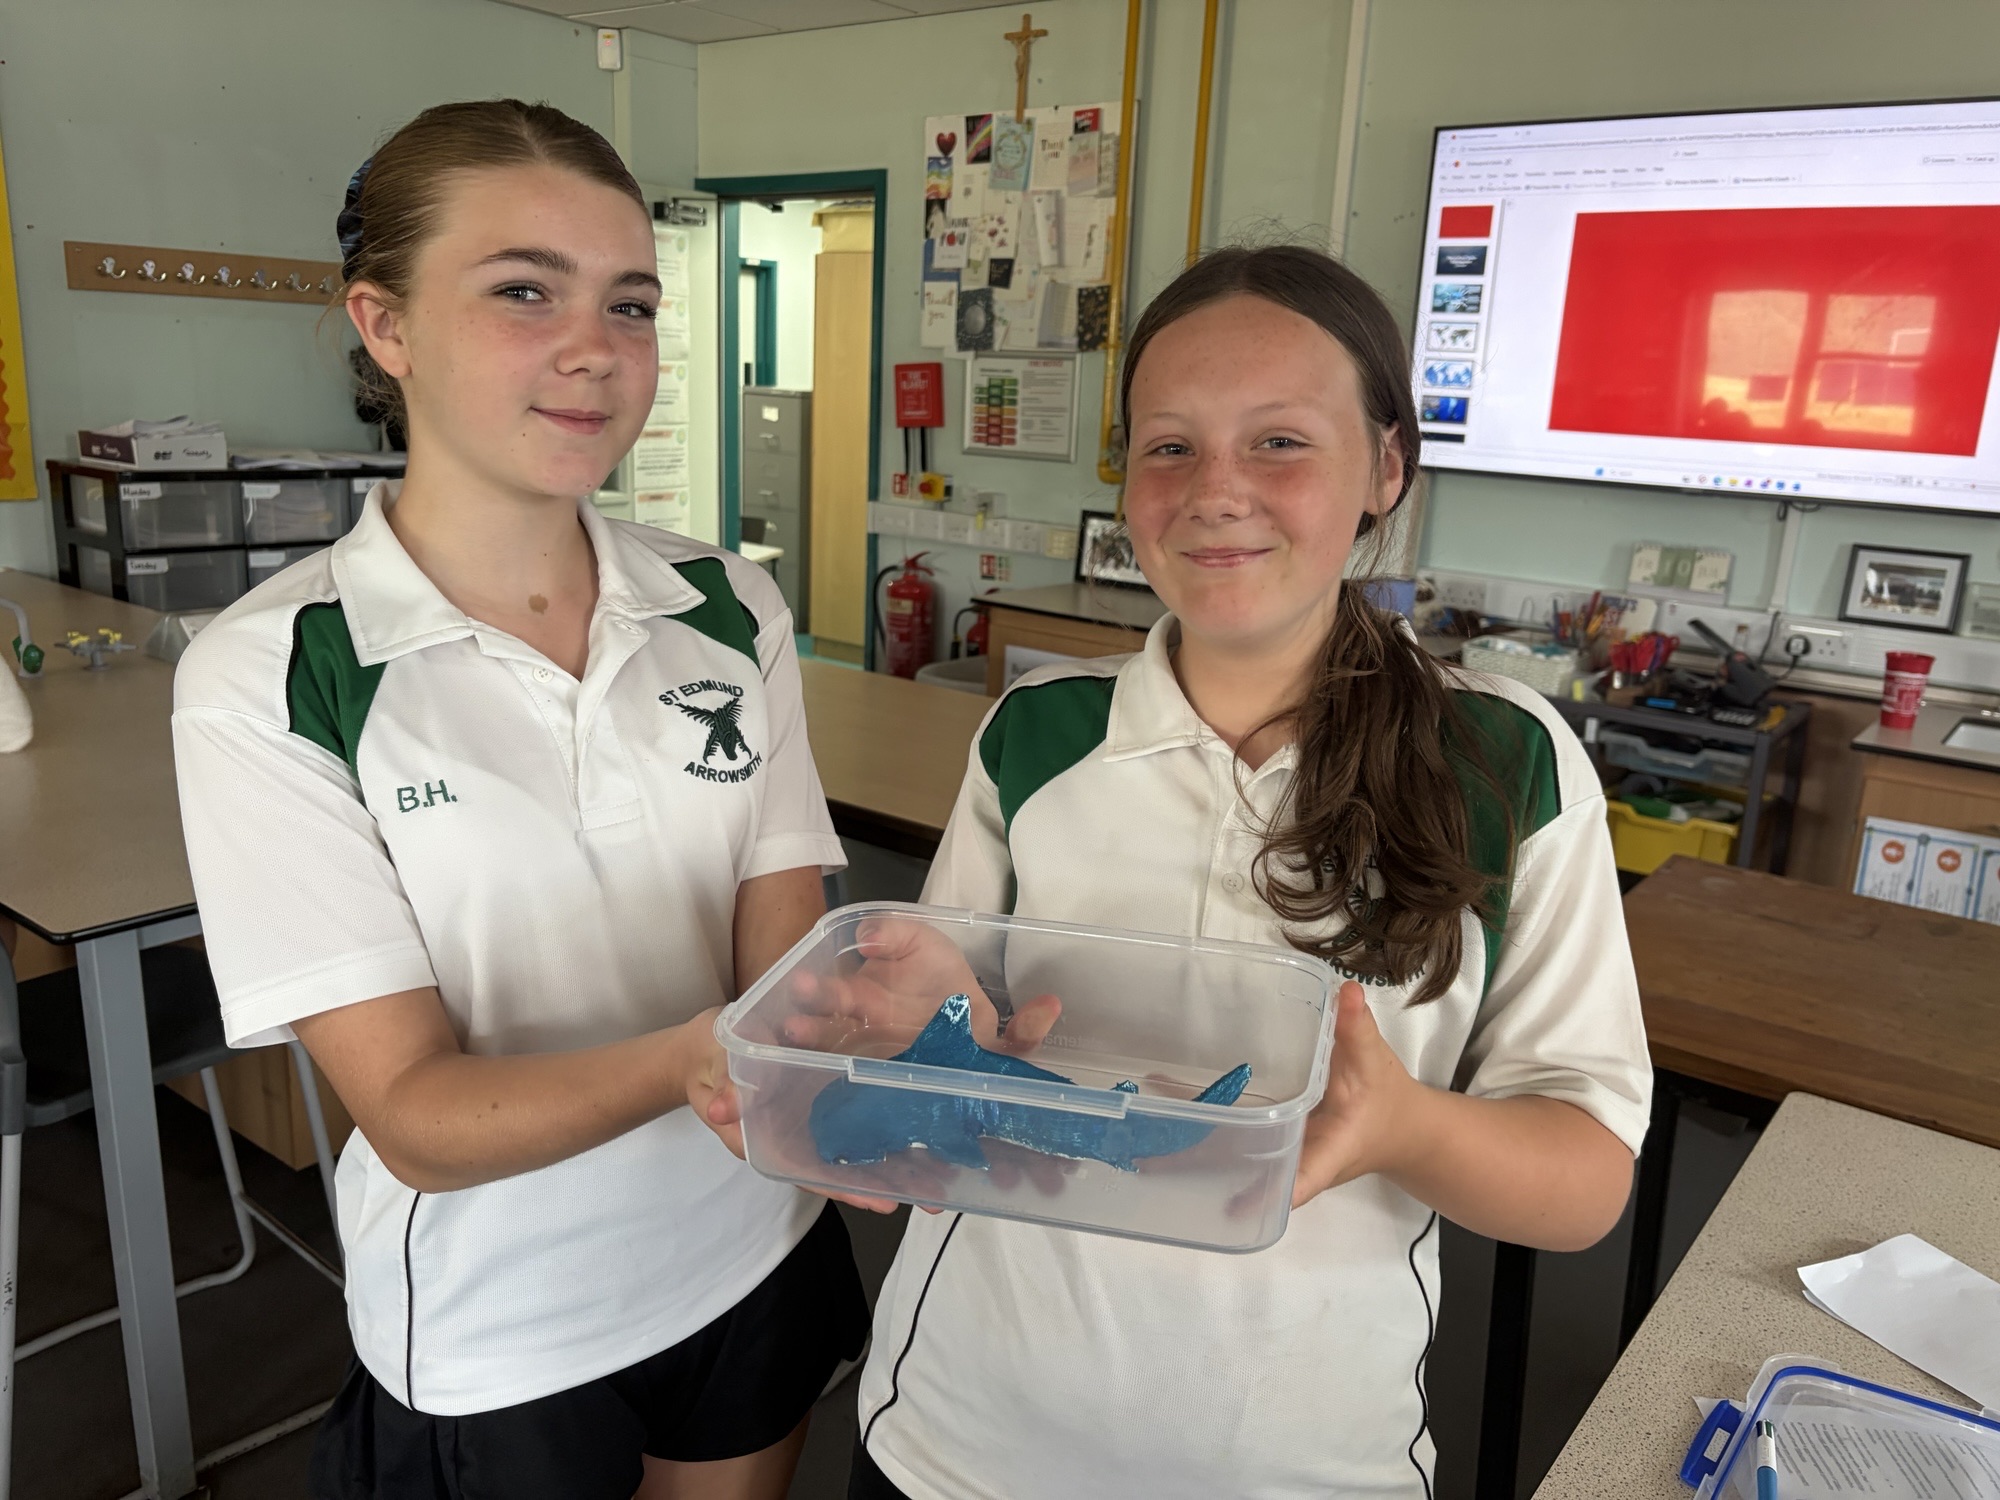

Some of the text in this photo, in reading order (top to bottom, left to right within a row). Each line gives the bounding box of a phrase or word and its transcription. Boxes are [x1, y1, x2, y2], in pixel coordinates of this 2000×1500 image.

[658, 679, 744, 706] ST EDMUND
[683, 751, 763, 784] ARROWSMITH
[397, 779, 458, 813] B.H.
